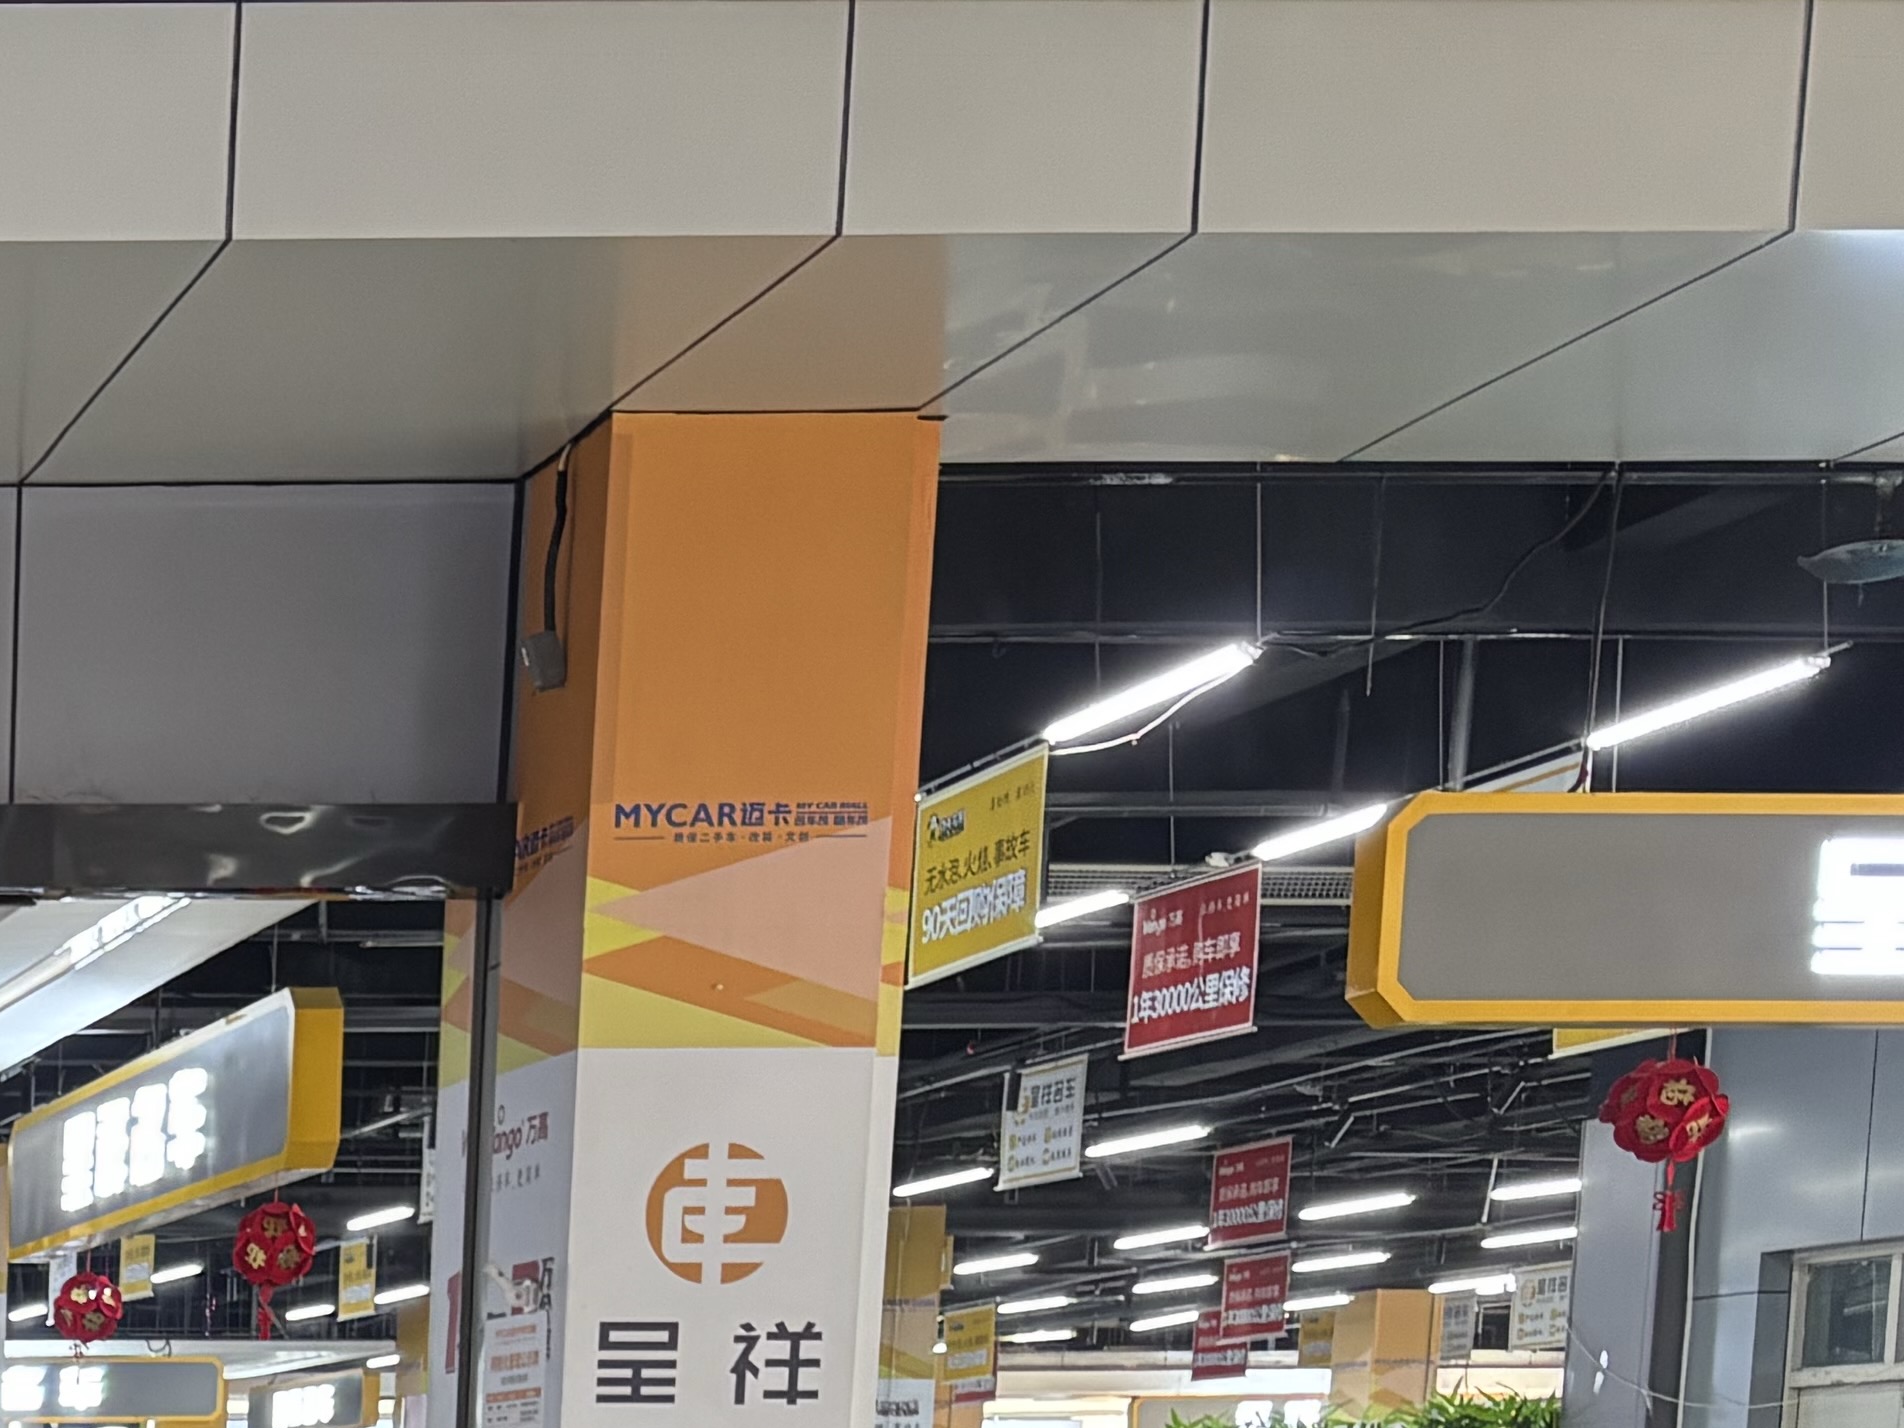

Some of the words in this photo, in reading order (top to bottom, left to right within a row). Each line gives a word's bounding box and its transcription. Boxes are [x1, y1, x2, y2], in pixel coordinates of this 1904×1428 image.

[614, 802, 792, 828] MYCAR迈卡
[921, 868, 1026, 945] 90天回购保障
[1130, 965, 1251, 1025] 1年30000公里保修
[596, 1320, 823, 1405] 呈祥
